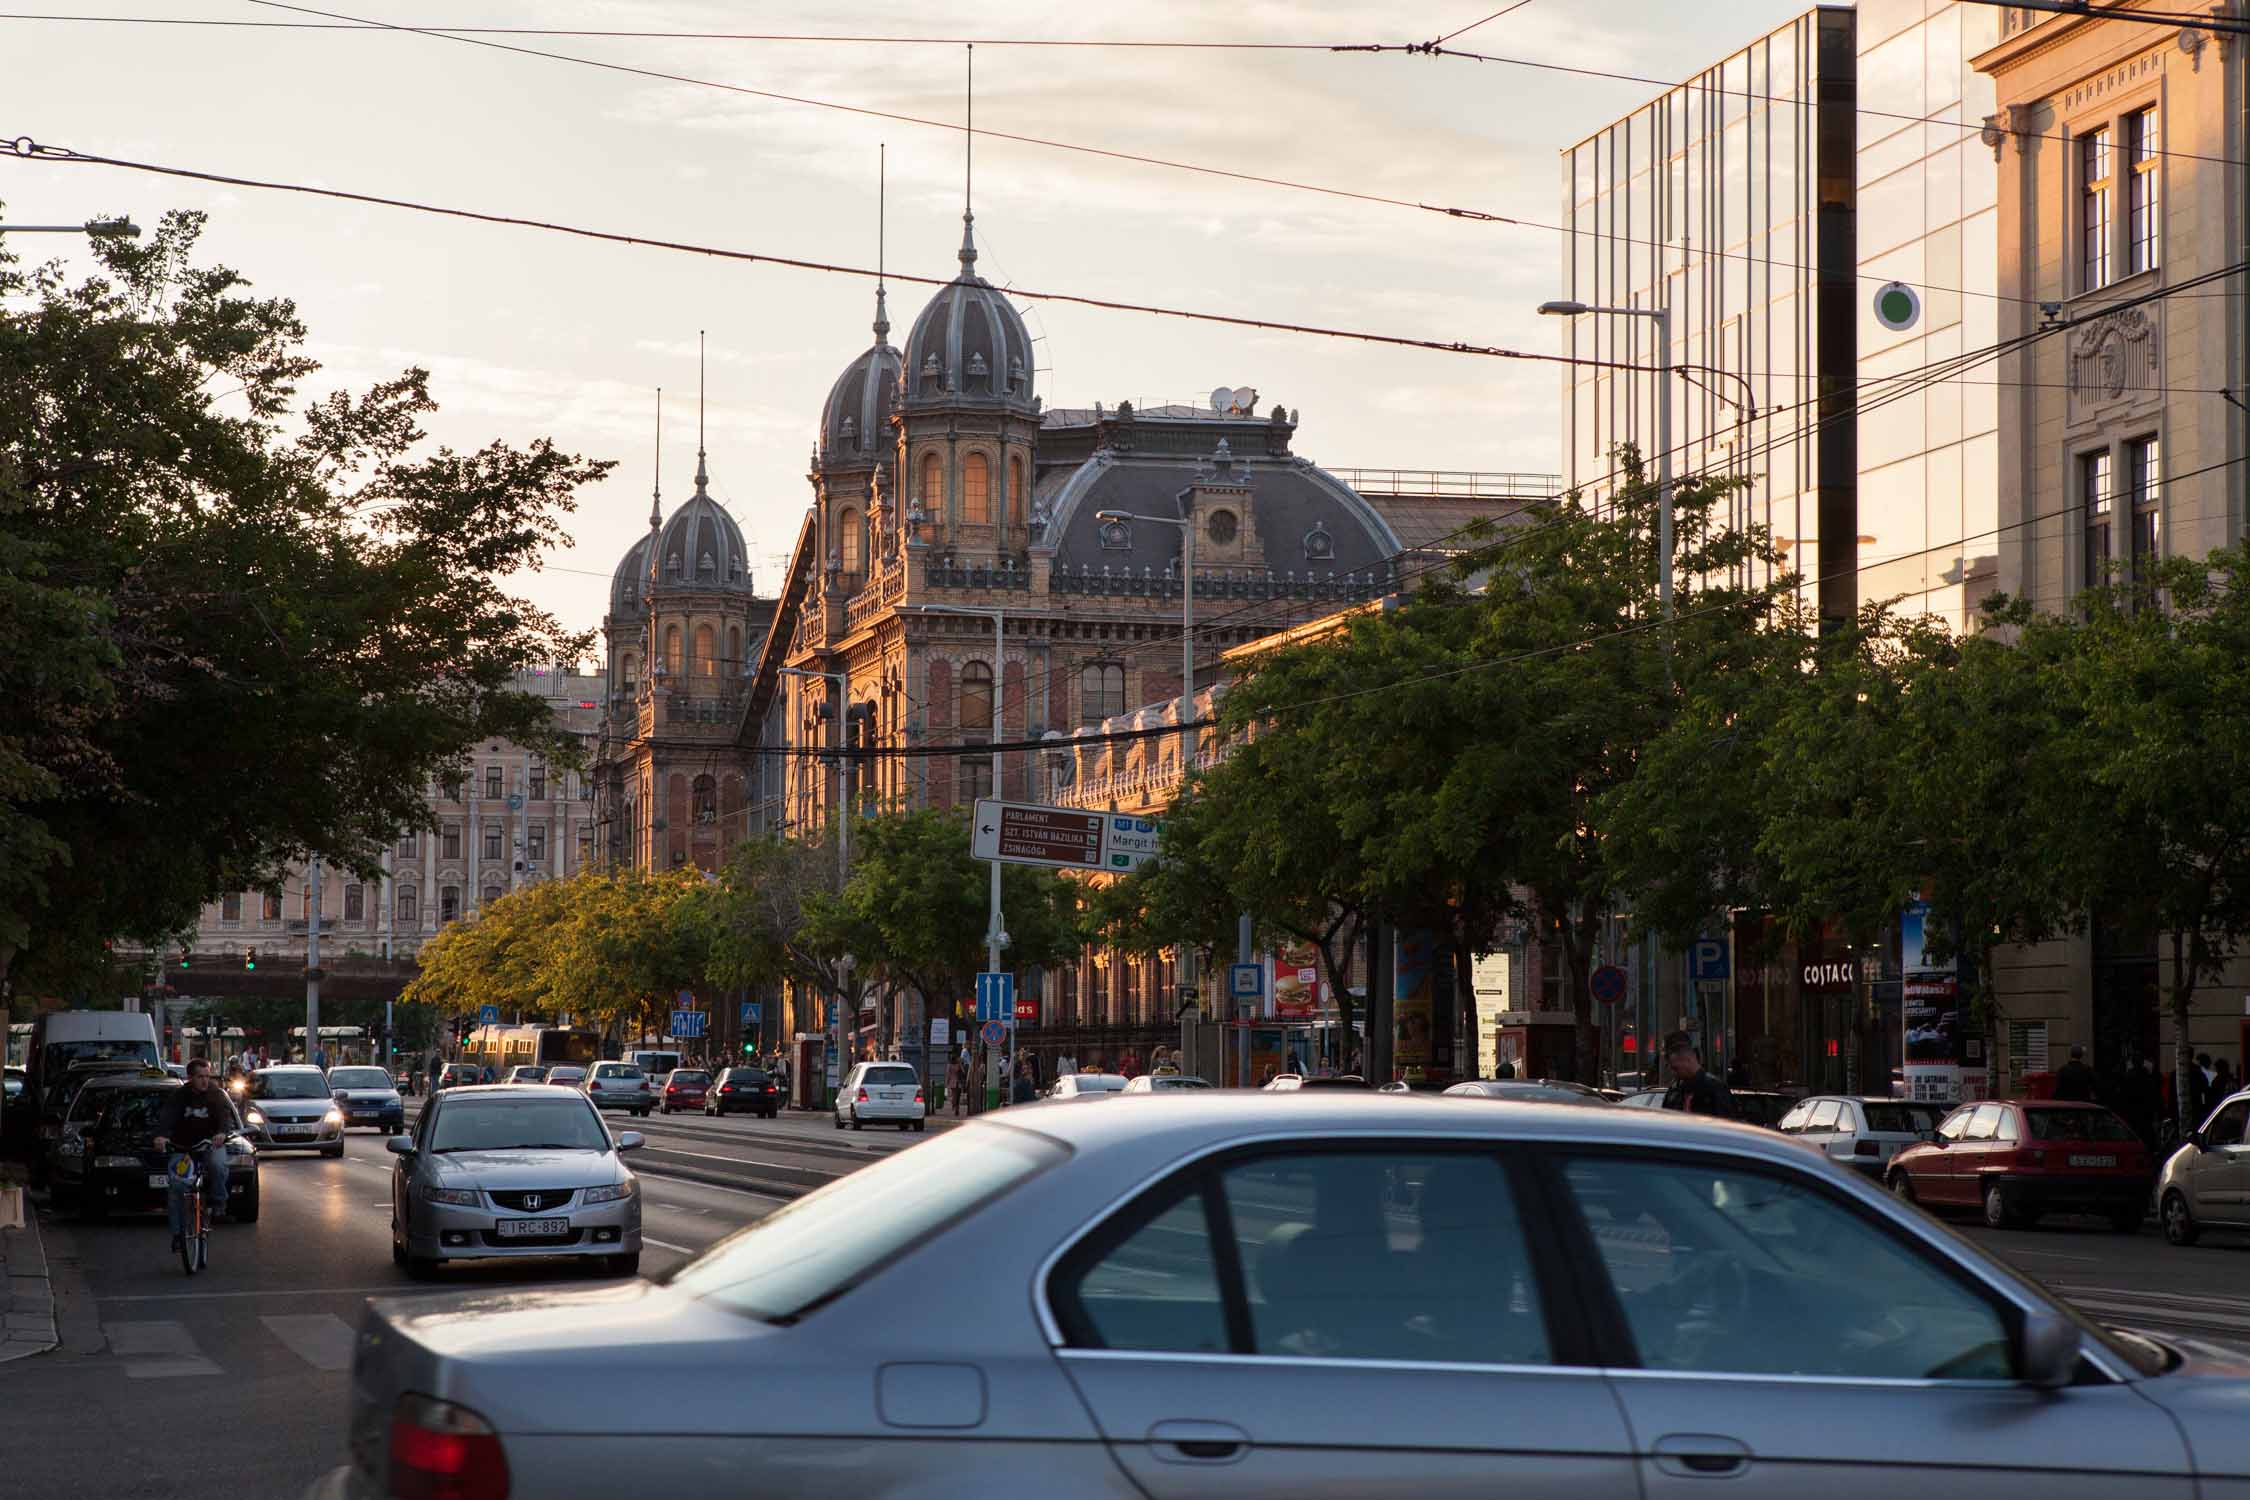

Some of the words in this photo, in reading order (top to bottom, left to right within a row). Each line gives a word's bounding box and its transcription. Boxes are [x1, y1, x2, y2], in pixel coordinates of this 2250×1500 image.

[1006, 810, 1049, 823] PARLAMENT
[1112, 834, 1148, 849] Margit
[1803, 963, 1840, 987] COSTA
